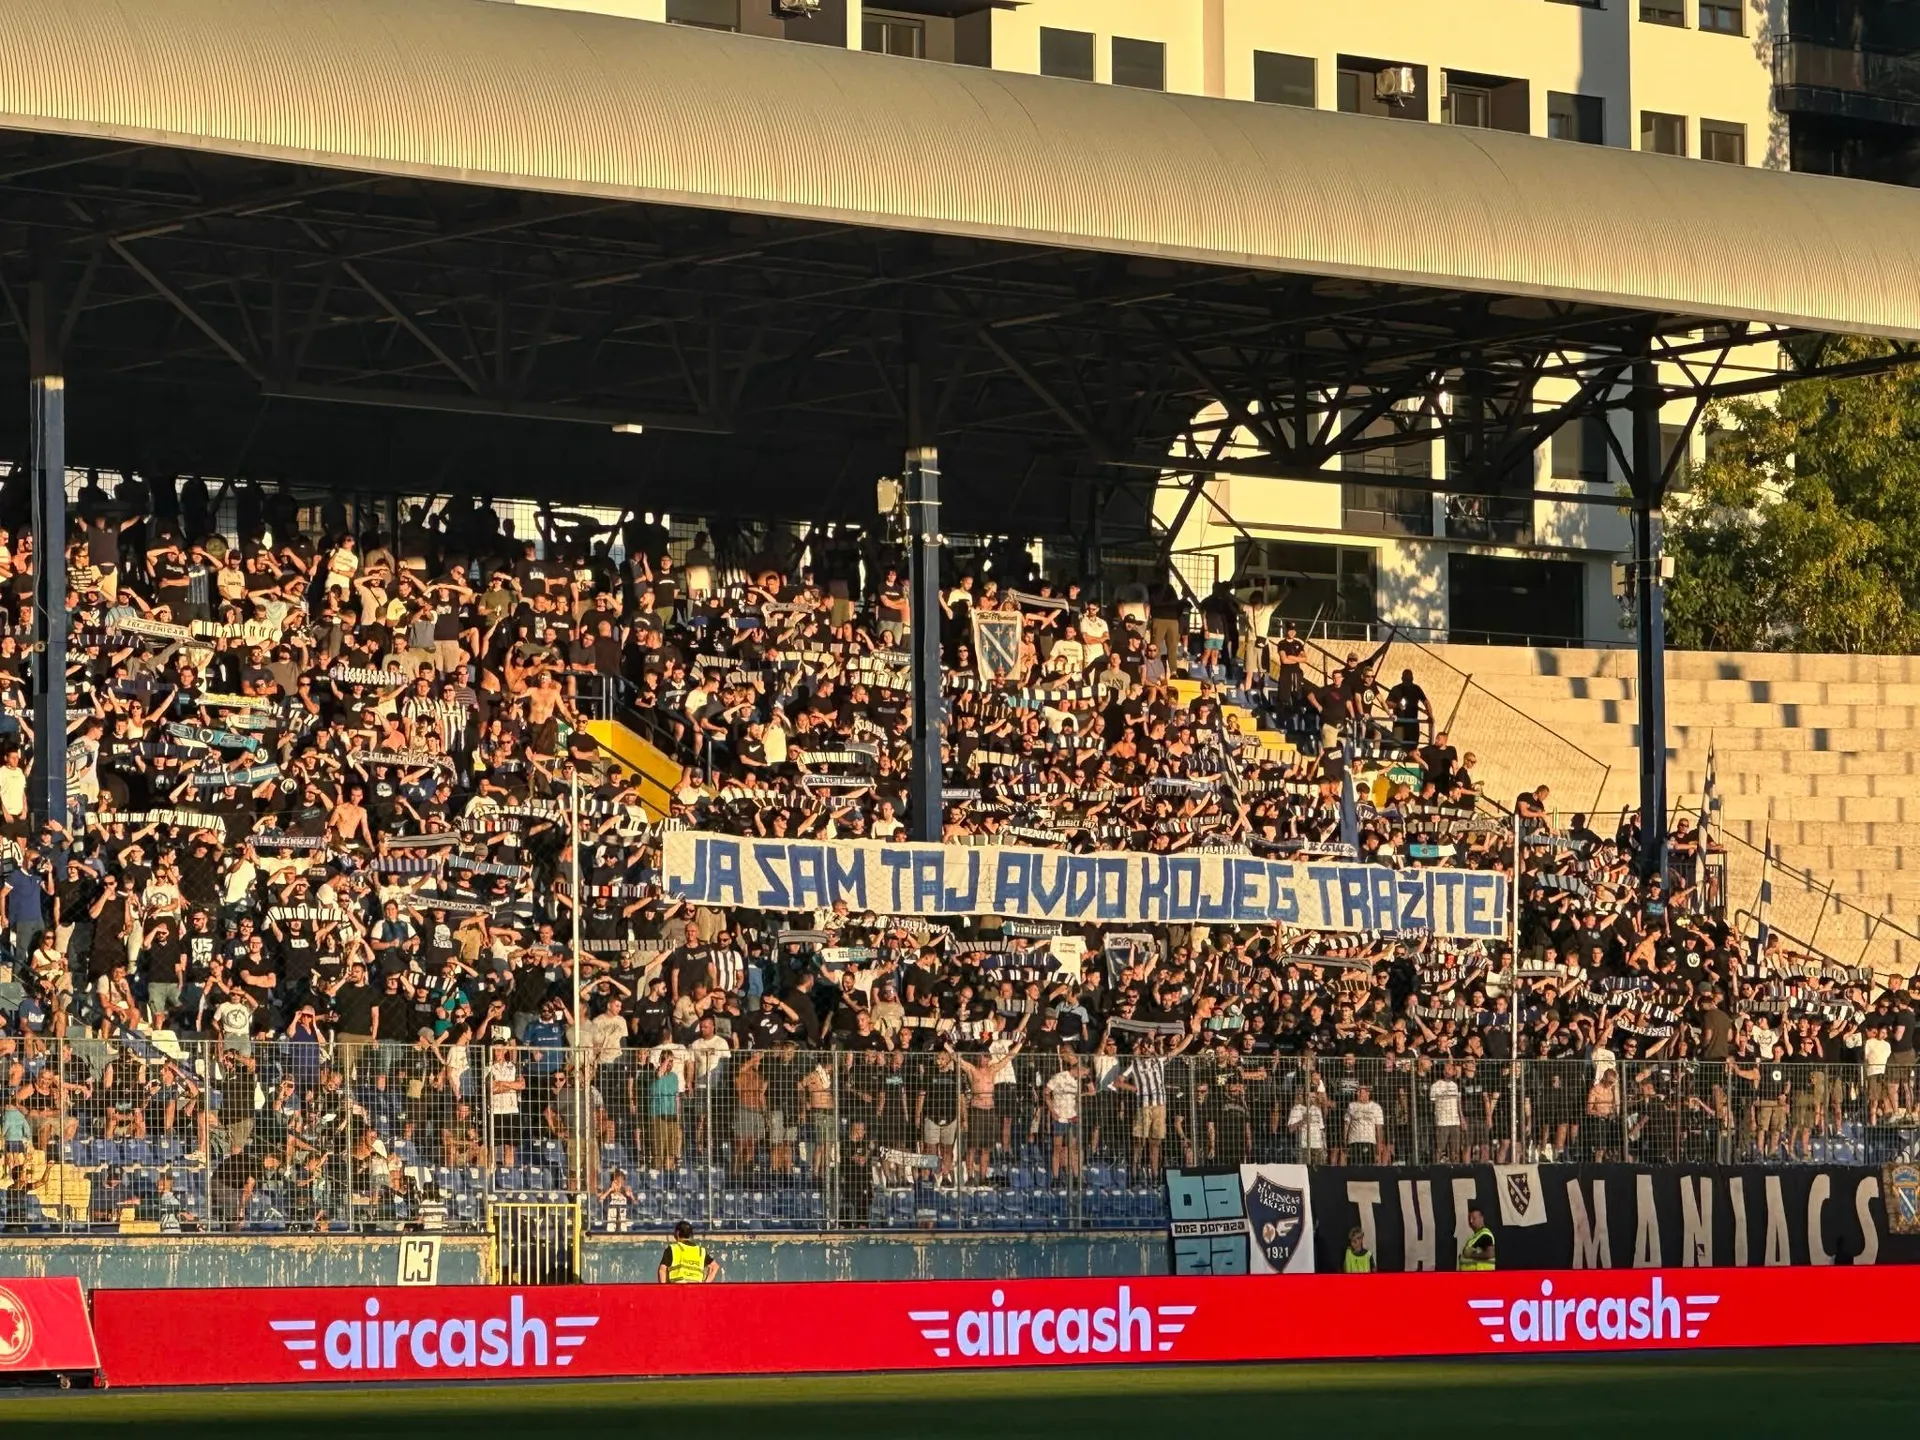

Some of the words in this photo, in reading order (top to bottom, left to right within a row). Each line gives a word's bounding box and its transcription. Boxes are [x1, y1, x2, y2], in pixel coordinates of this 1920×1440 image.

[669, 839, 743, 905] JA
[753, 844, 867, 908] SAM
[881, 848, 980, 911] TAJ
[993, 852, 1128, 919] AVDO
[1141, 856, 1299, 921] KOJEG
[1308, 866, 1504, 934] TRAŽITE!
[1266, 1246, 1289, 1259] 1921
[1566, 1174, 1879, 1269] MANIACS
[324, 1295, 548, 1370] aircash
[956, 1285, 1152, 1356] aircash
[1510, 1276, 1681, 1342] aircash
